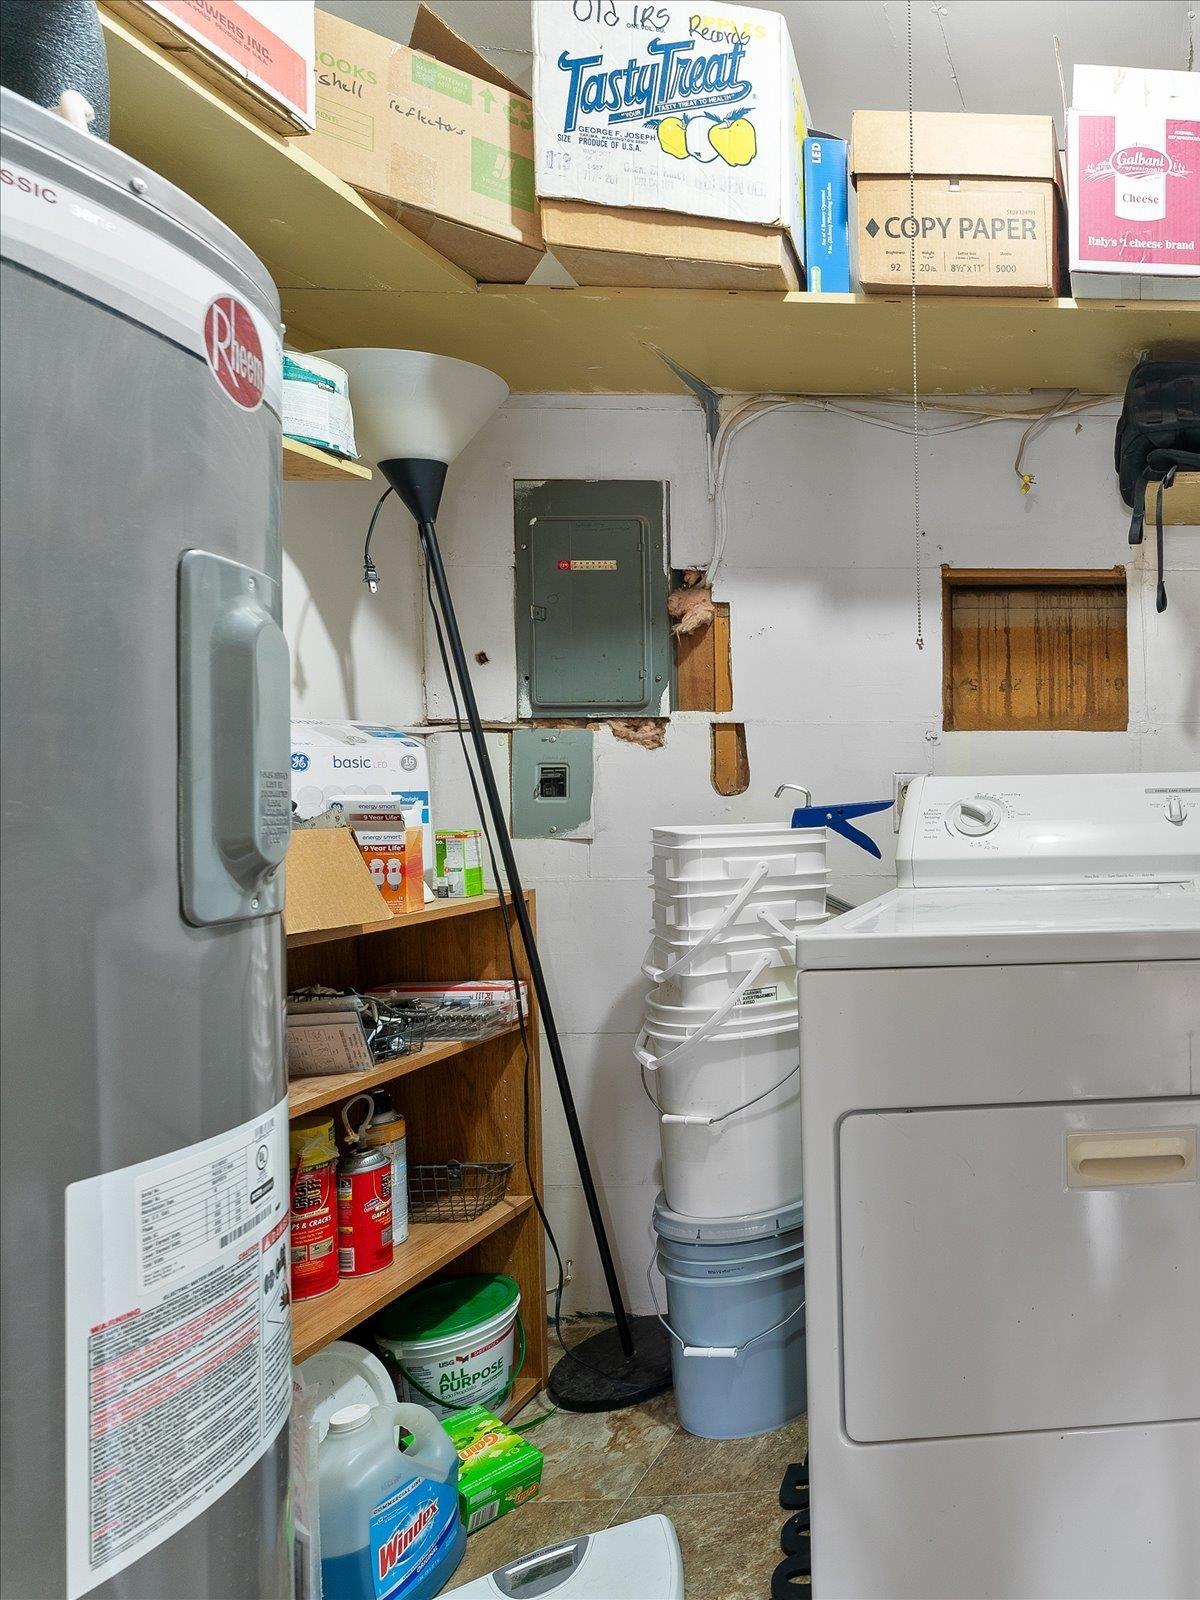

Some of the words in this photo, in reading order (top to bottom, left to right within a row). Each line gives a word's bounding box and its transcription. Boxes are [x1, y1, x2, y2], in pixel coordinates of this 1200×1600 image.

[573, 0, 619, 27] Old
[633, 5, 670, 29] IRS
[688, 14, 751, 46] Records
[193, 0, 244, 39] OWERS
[247, 35, 274, 63] INC.
[315, 51, 377, 86] OOKS
[314, 68, 363, 98] shell
[389, 99, 467, 136] reflectors
[657, 101, 677, 112] TASTY
[679, 99, 698, 109] TREAT
[699, 98, 707, 106] TO
[557, 134, 571, 143] SIZE
[578, 125, 613, 136] GEORGE
[615, 130, 623, 138] F.
[624, 131, 656, 141] JOSEPH
[601, 135, 634, 143] WASHINGTON
[578, 137, 608, 149] PRODUCE
[610, 141, 620, 150] OF
[622, 142, 642, 152] U.S.A.
[811, 142, 822, 163] LED
[1116, 151, 1165, 167] Galbani
[0, 169, 57, 204] SSIC
[1122, 193, 1159, 204] Cheese
[884, 216, 952, 239] COPY
[959, 217, 1037, 240] PAPER
[1088, 236, 1118, 249] Italy's
[1129, 239, 1163, 250] cheese
[1165, 239, 1195, 251] brand
[890, 263, 901, 272] 92
[996, 264, 1017, 273] 5000
[212, 300, 263, 390] Rheem
[333, 755, 371, 769] basic
[403, 755, 415, 764] 16
[301, 1221, 308, 1229] &
[309, 1215, 332, 1227] CRACKS
[371, 1209, 386, 1220] GAPS
[438, 1359, 455, 1369] USG
[439, 1356, 504, 1395] PURPOSE
[439, 1367, 469, 1385] ALL
[458, 1432, 499, 1461] Gain
[373, 1489, 411, 1514] COMMERCIAL
[379, 1502, 439, 1580] Windex
